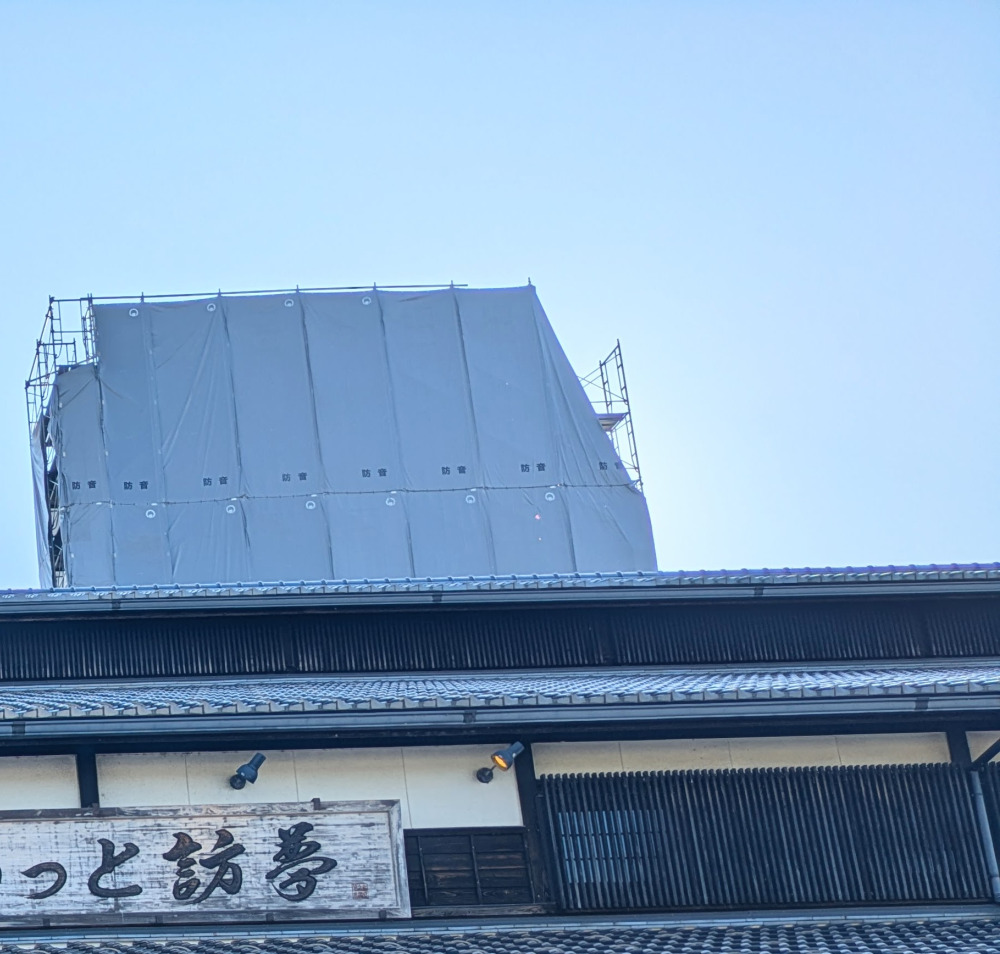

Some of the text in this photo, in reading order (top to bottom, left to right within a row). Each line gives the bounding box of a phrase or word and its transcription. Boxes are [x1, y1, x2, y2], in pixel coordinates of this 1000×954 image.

[361, 468, 387, 478] 防音
[441, 465, 467, 475] 防音
[520, 463, 546, 473] 防音
[203, 476, 229, 487] 防音
[282, 472, 308, 482] 防音
[71, 480, 97, 490] 防音
[123, 480, 149, 490] 防音
